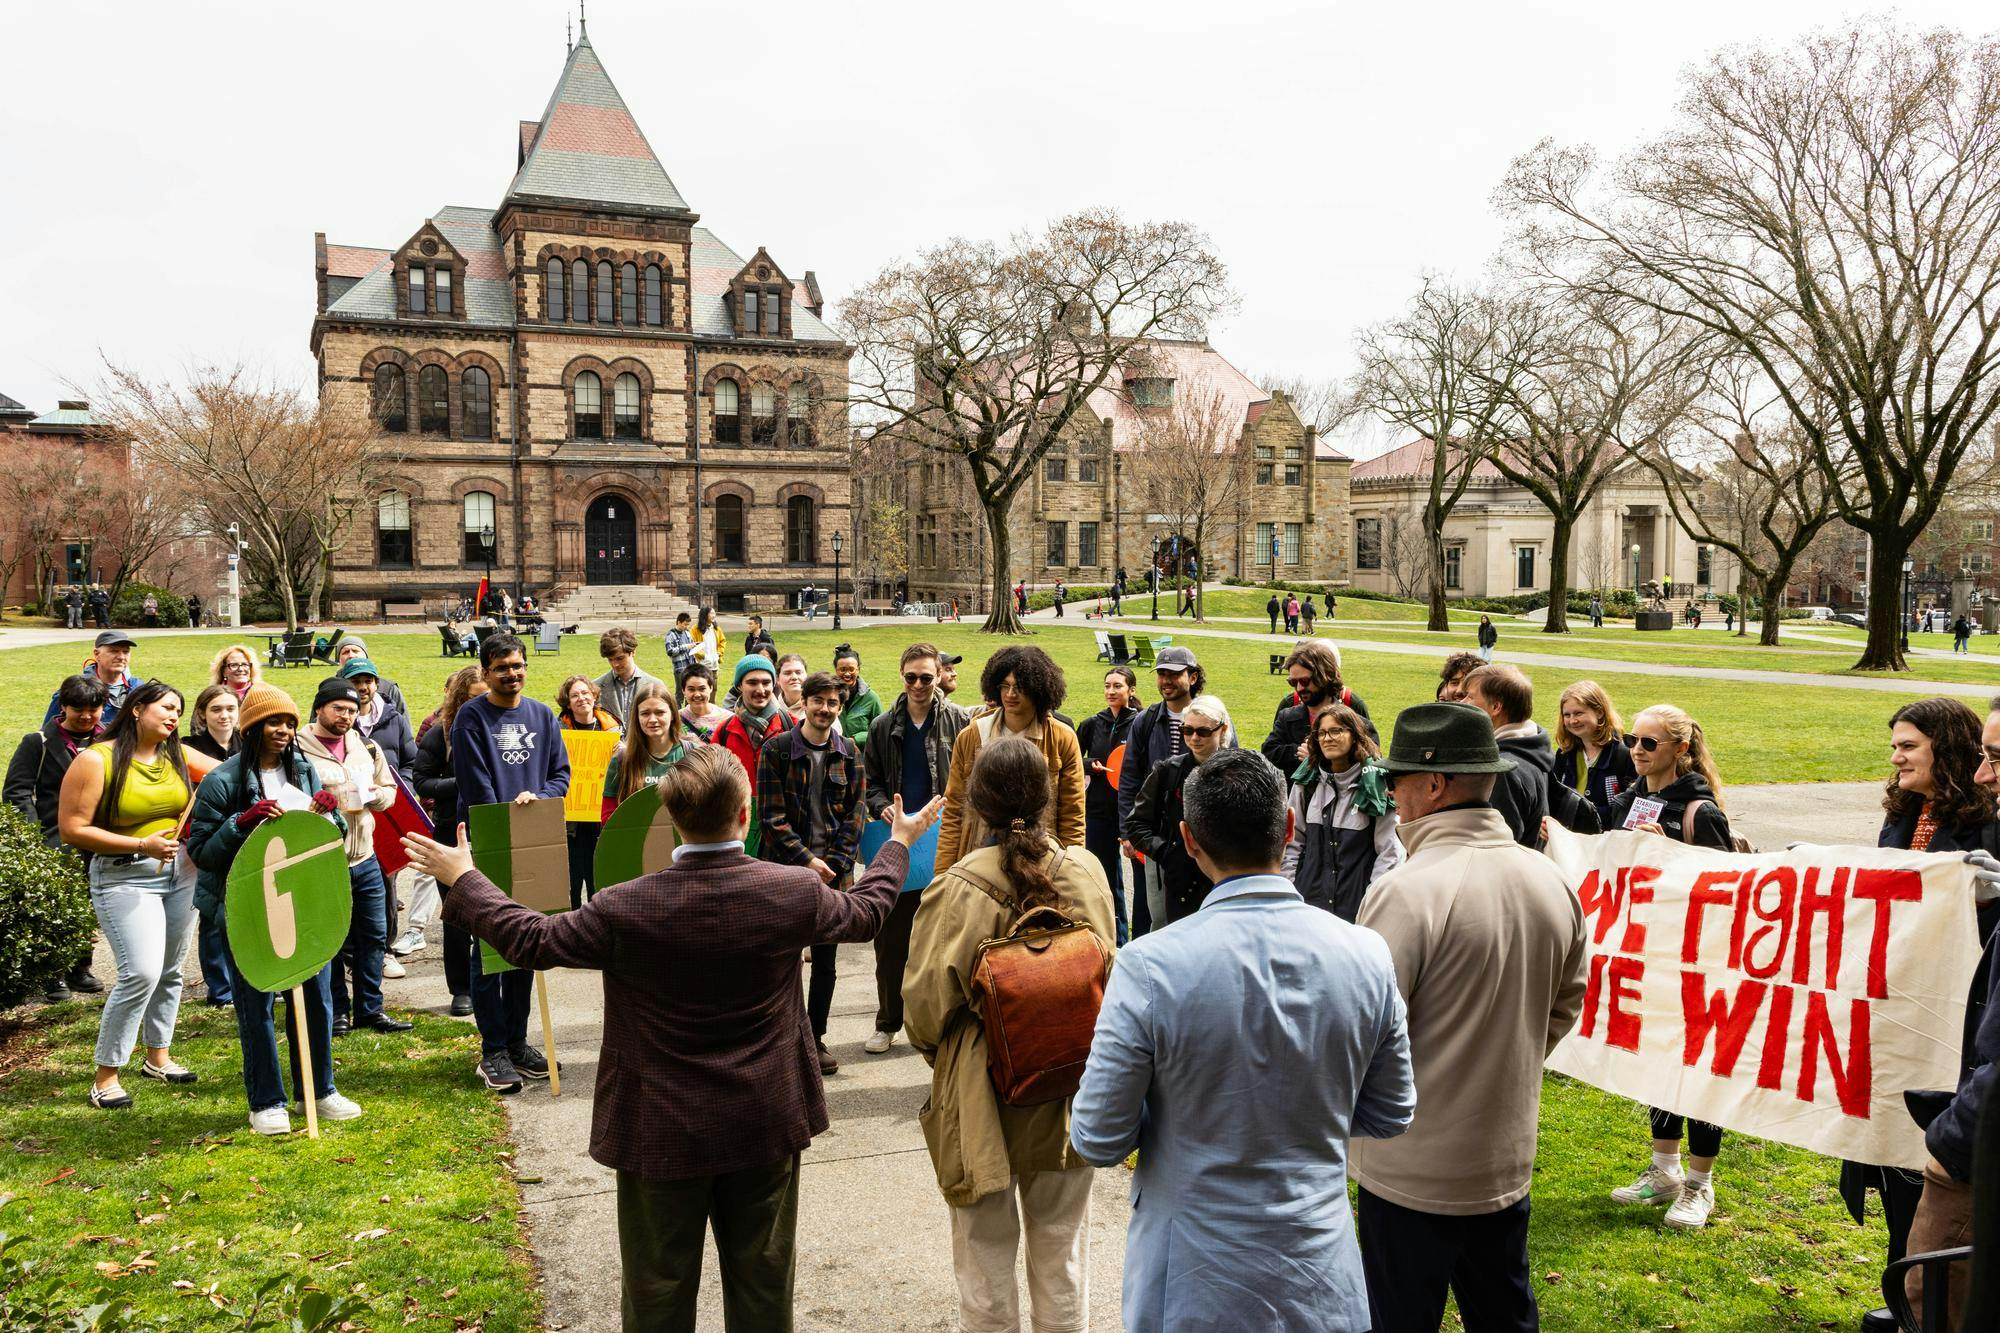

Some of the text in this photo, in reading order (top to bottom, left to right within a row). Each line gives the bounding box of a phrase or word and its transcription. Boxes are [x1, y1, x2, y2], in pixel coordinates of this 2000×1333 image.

[564, 738, 613, 769] NION
[1577, 866, 1663, 954] WE
[1680, 970, 1871, 1120] WIN
